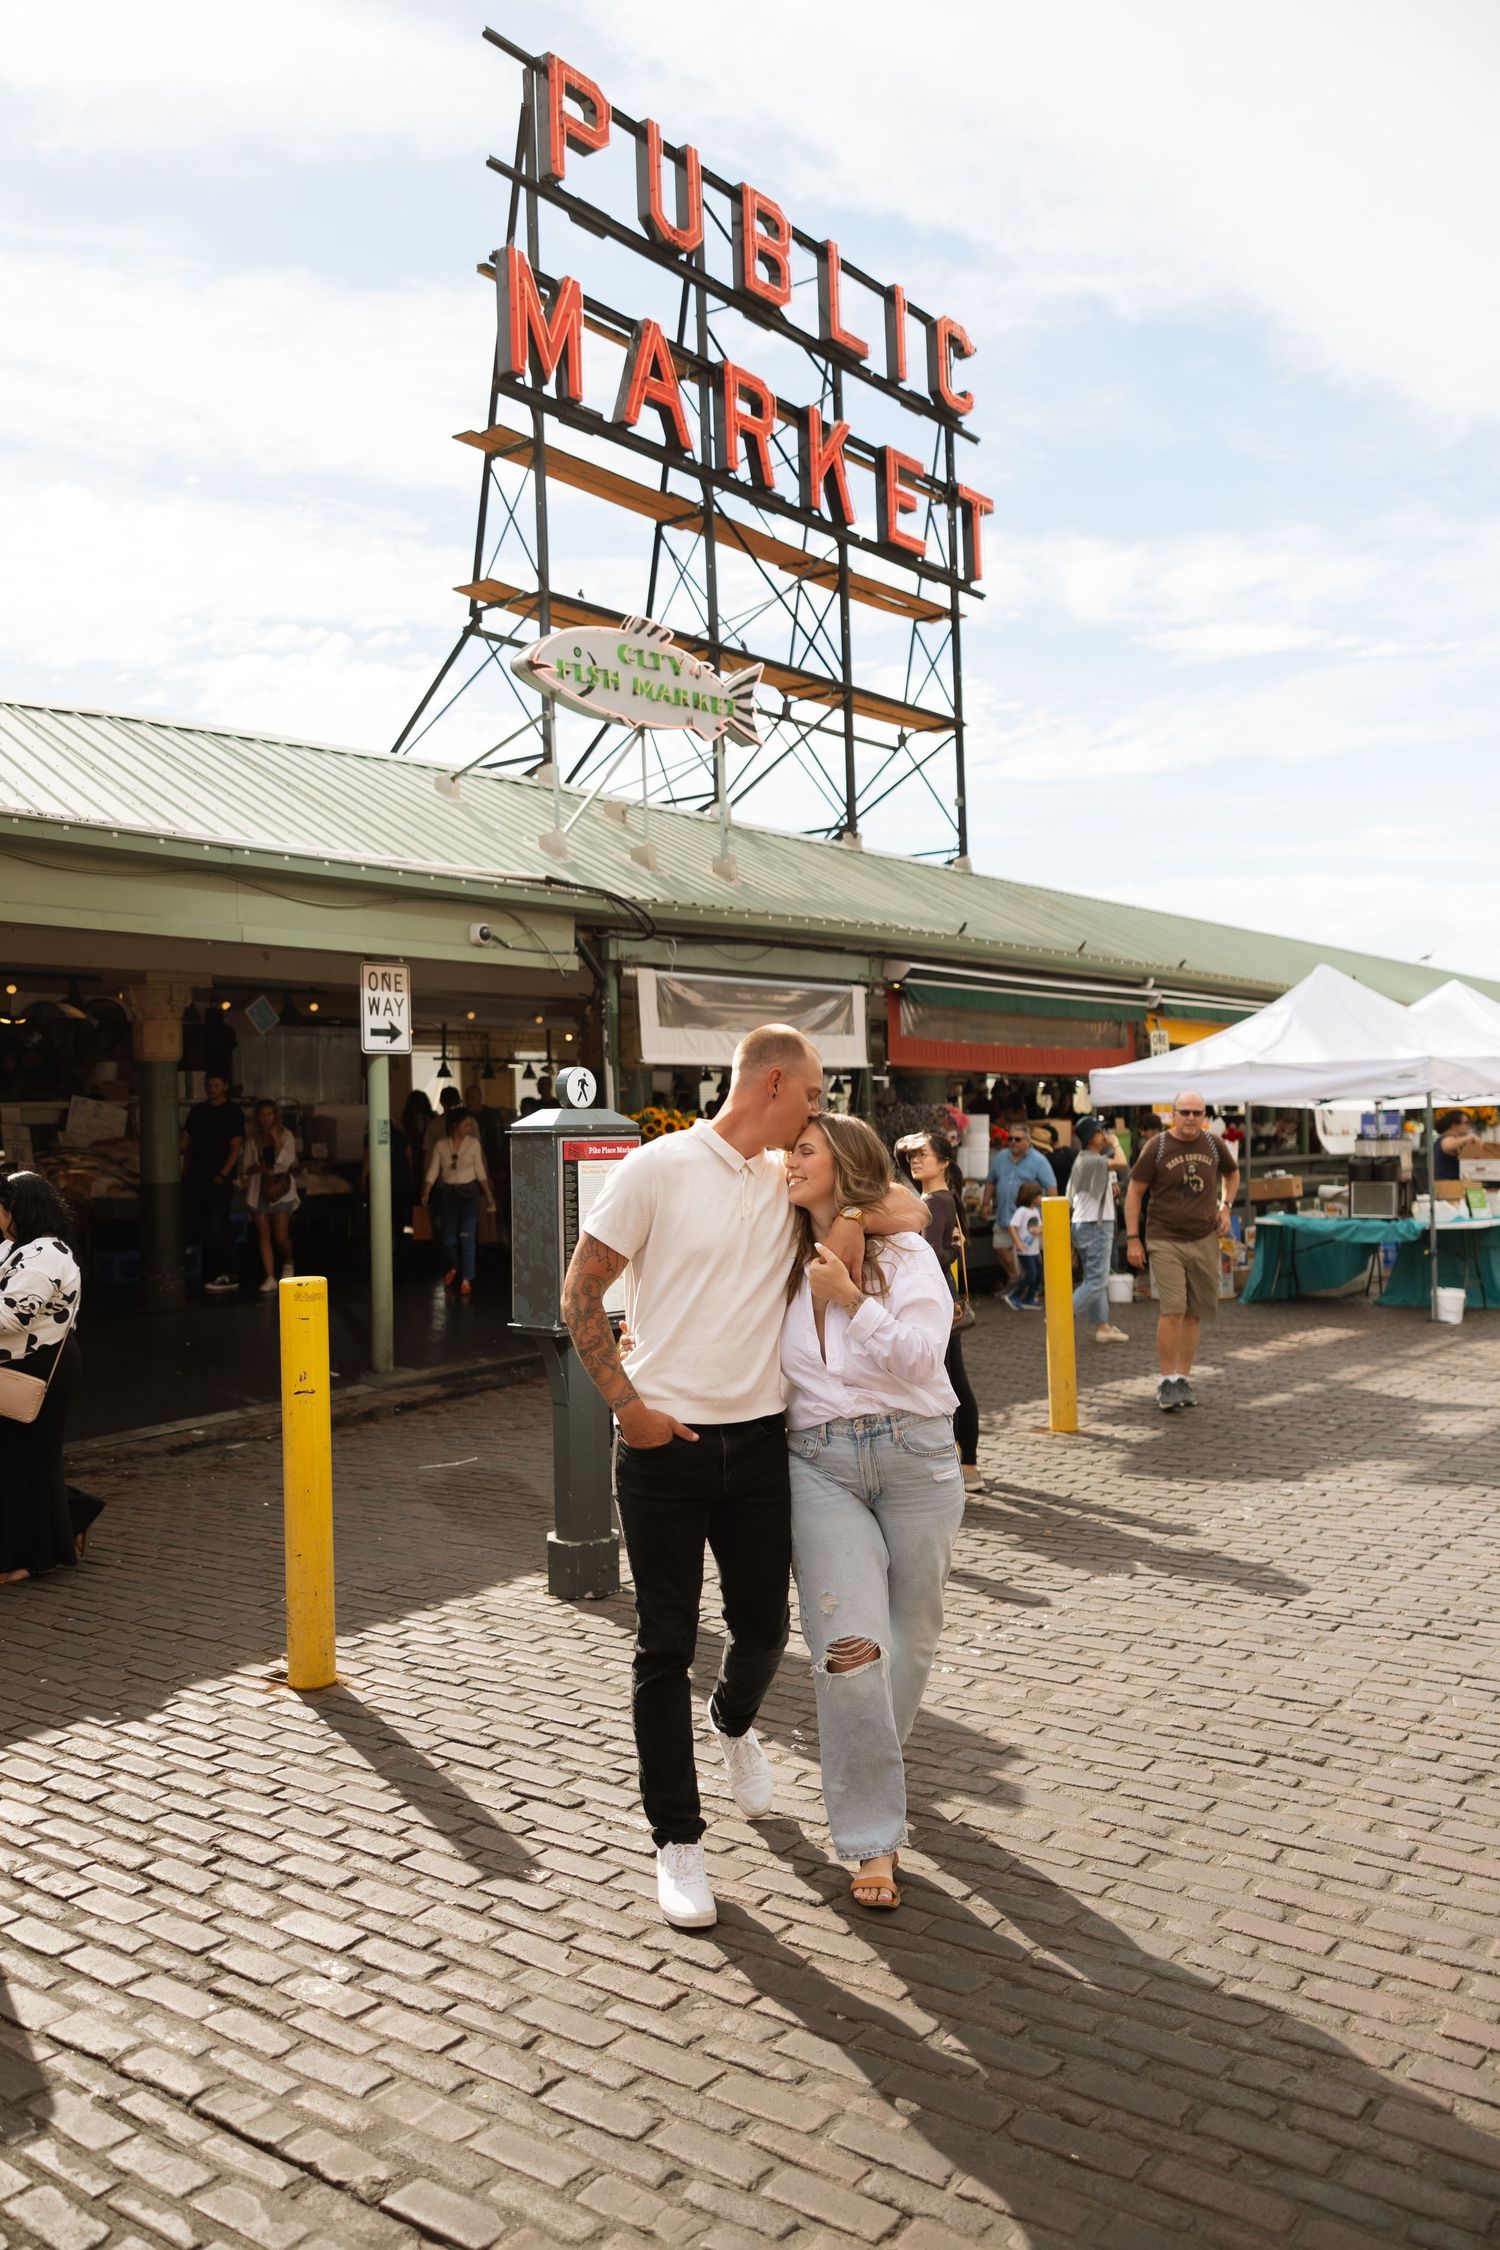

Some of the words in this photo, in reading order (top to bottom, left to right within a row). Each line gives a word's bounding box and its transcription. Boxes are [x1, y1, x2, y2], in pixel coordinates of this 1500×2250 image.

[536, 51, 977, 416] PUBLIC
[496, 244, 994, 580] MARKET
[617, 643, 685, 676] CITY
[556, 658, 621, 691] FISH
[632, 676, 738, 717] MARKET
[368, 971, 404, 993] ONE
[368, 996, 405, 1017] WAY
[588, 1146, 602, 1154] Pike
[602, 1146, 617, 1154] Place
